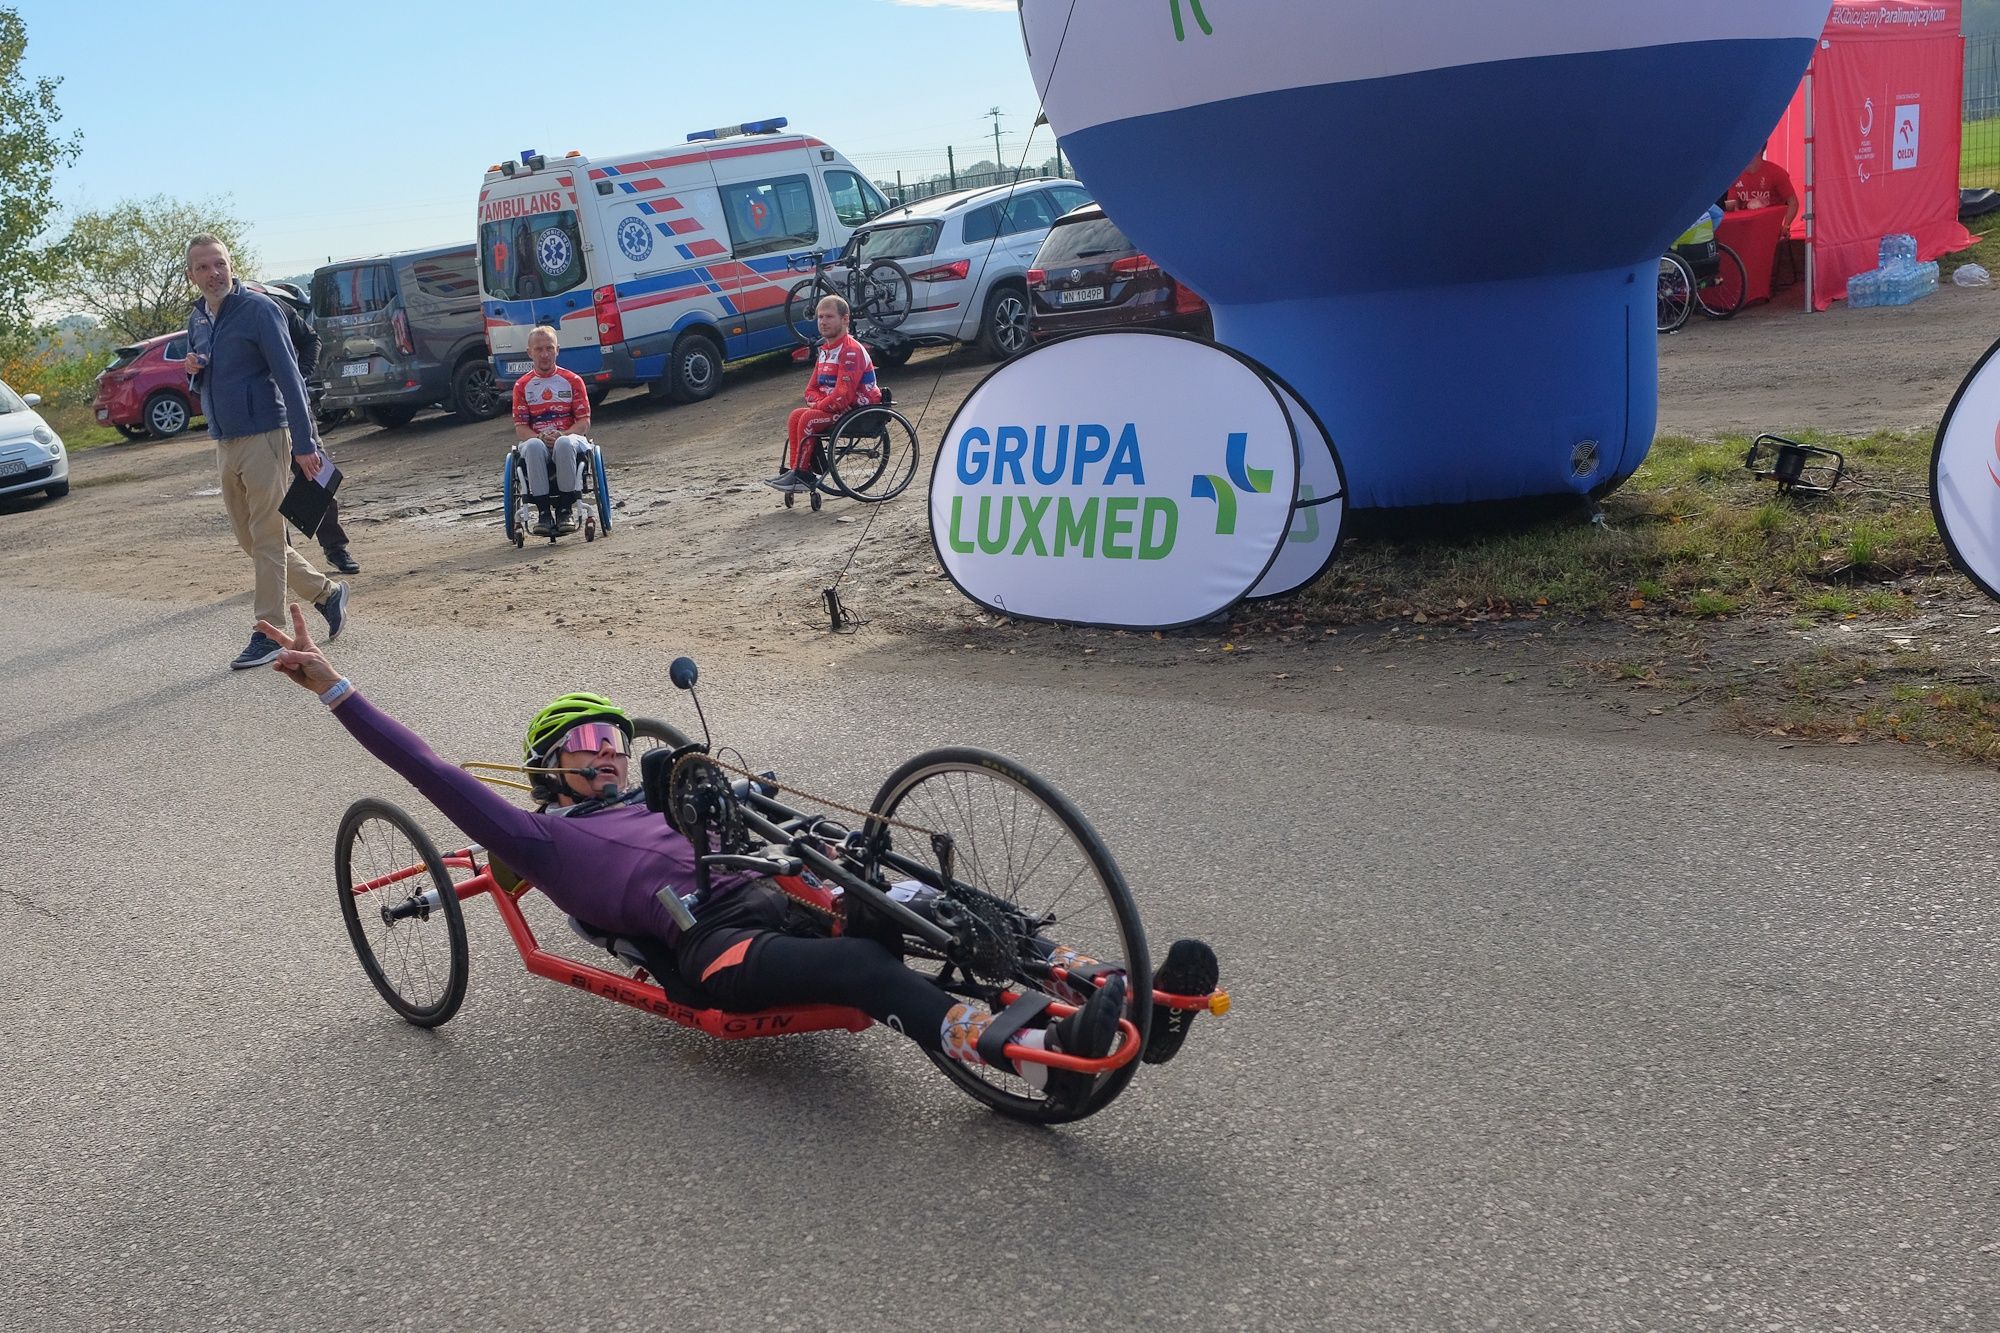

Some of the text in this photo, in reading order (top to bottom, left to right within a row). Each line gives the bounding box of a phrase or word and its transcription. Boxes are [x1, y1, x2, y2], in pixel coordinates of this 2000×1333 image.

[1897, 148, 1914, 159] ORLEN
[485, 191, 561, 222] AMBULANS
[1063, 288, 1103, 303] WN 1049P
[956, 423, 1145, 486] GRUPA
[948, 496, 1178, 560] LUXMED
